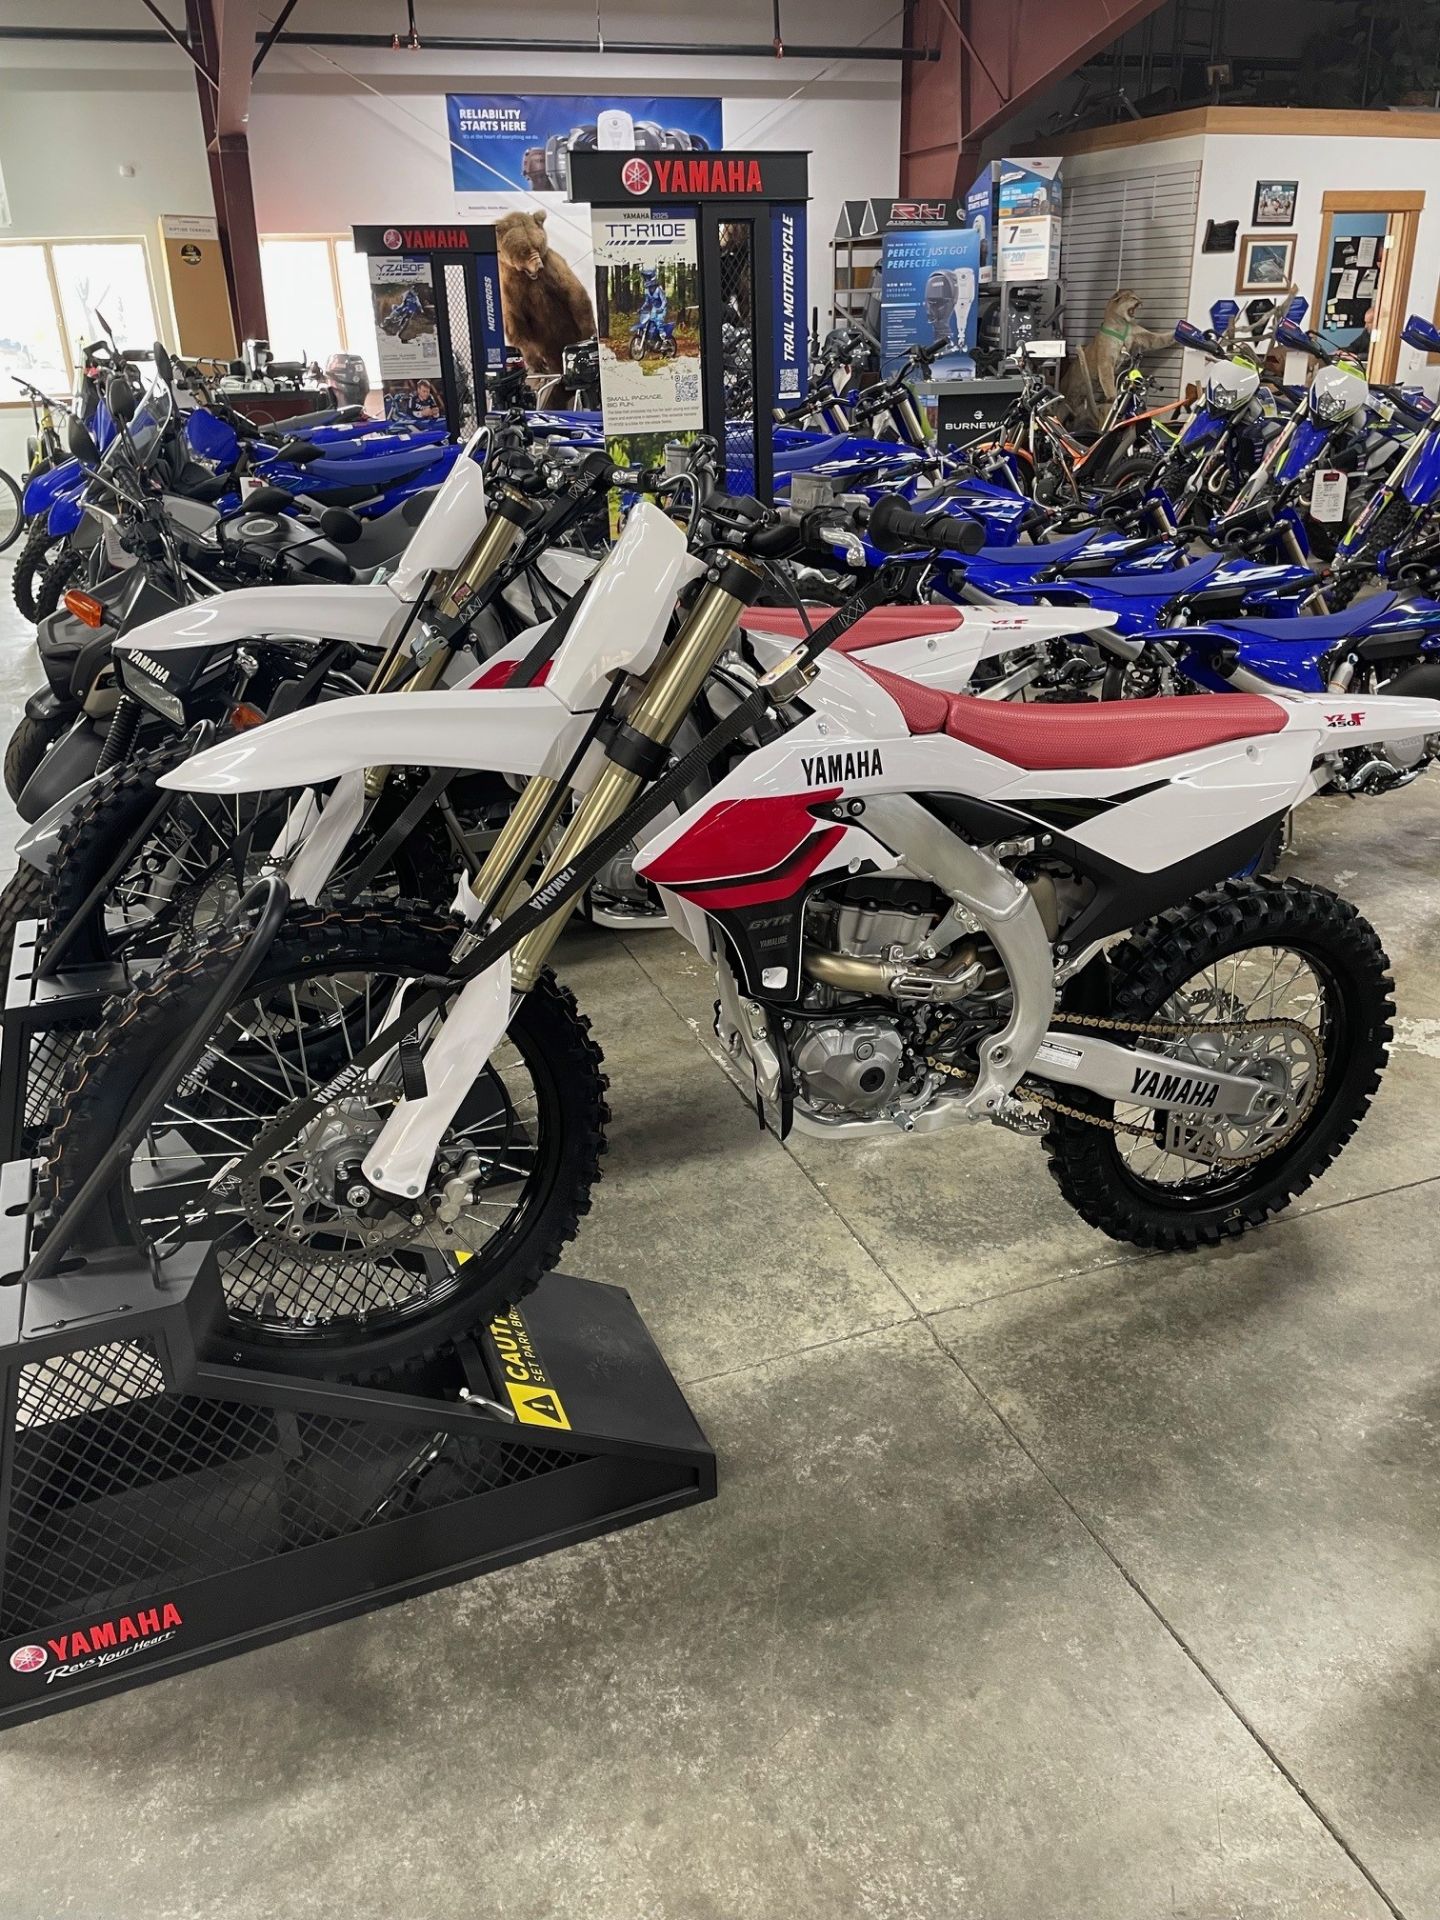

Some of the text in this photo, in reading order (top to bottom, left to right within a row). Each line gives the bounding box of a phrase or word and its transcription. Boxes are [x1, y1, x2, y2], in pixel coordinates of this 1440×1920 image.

[459, 109, 521, 120] RELIABILITY
[460, 120, 527, 131] STARTS HERE
[654, 160, 763, 193] YAMAHA
[402, 229, 470, 249] YAMAHA
[605, 224, 686, 238] TT-R110E
[1008, 225, 1019, 244] 7
[887, 246, 968, 258] PERFECT JUST GOT
[887, 259, 940, 269] PERFECTED.
[376, 263, 425, 272] YZ450F
[782, 213, 795, 362] TRAIL MOTORCYCLE
[484, 276, 496, 332] MOTOCROSS
[945, 421, 1003, 430] BURNEW
[127, 648, 171, 684] YAMAHA
[1323, 713, 1347, 722] YZ
[801, 748, 883, 786] YAMAHA
[528, 866, 577, 911] YAMAHA
[312, 1064, 365, 1104] YAMAHA
[1130, 1067, 1221, 1108] YAMAHA
[489, 1314, 530, 1381] CAUTI
[514, 1329, 536, 1359] PARK
[527, 1361, 546, 1382] SET
[47, 1603, 183, 1661] YAMAHA
[44, 1632, 172, 1685] Revs Your Heart
